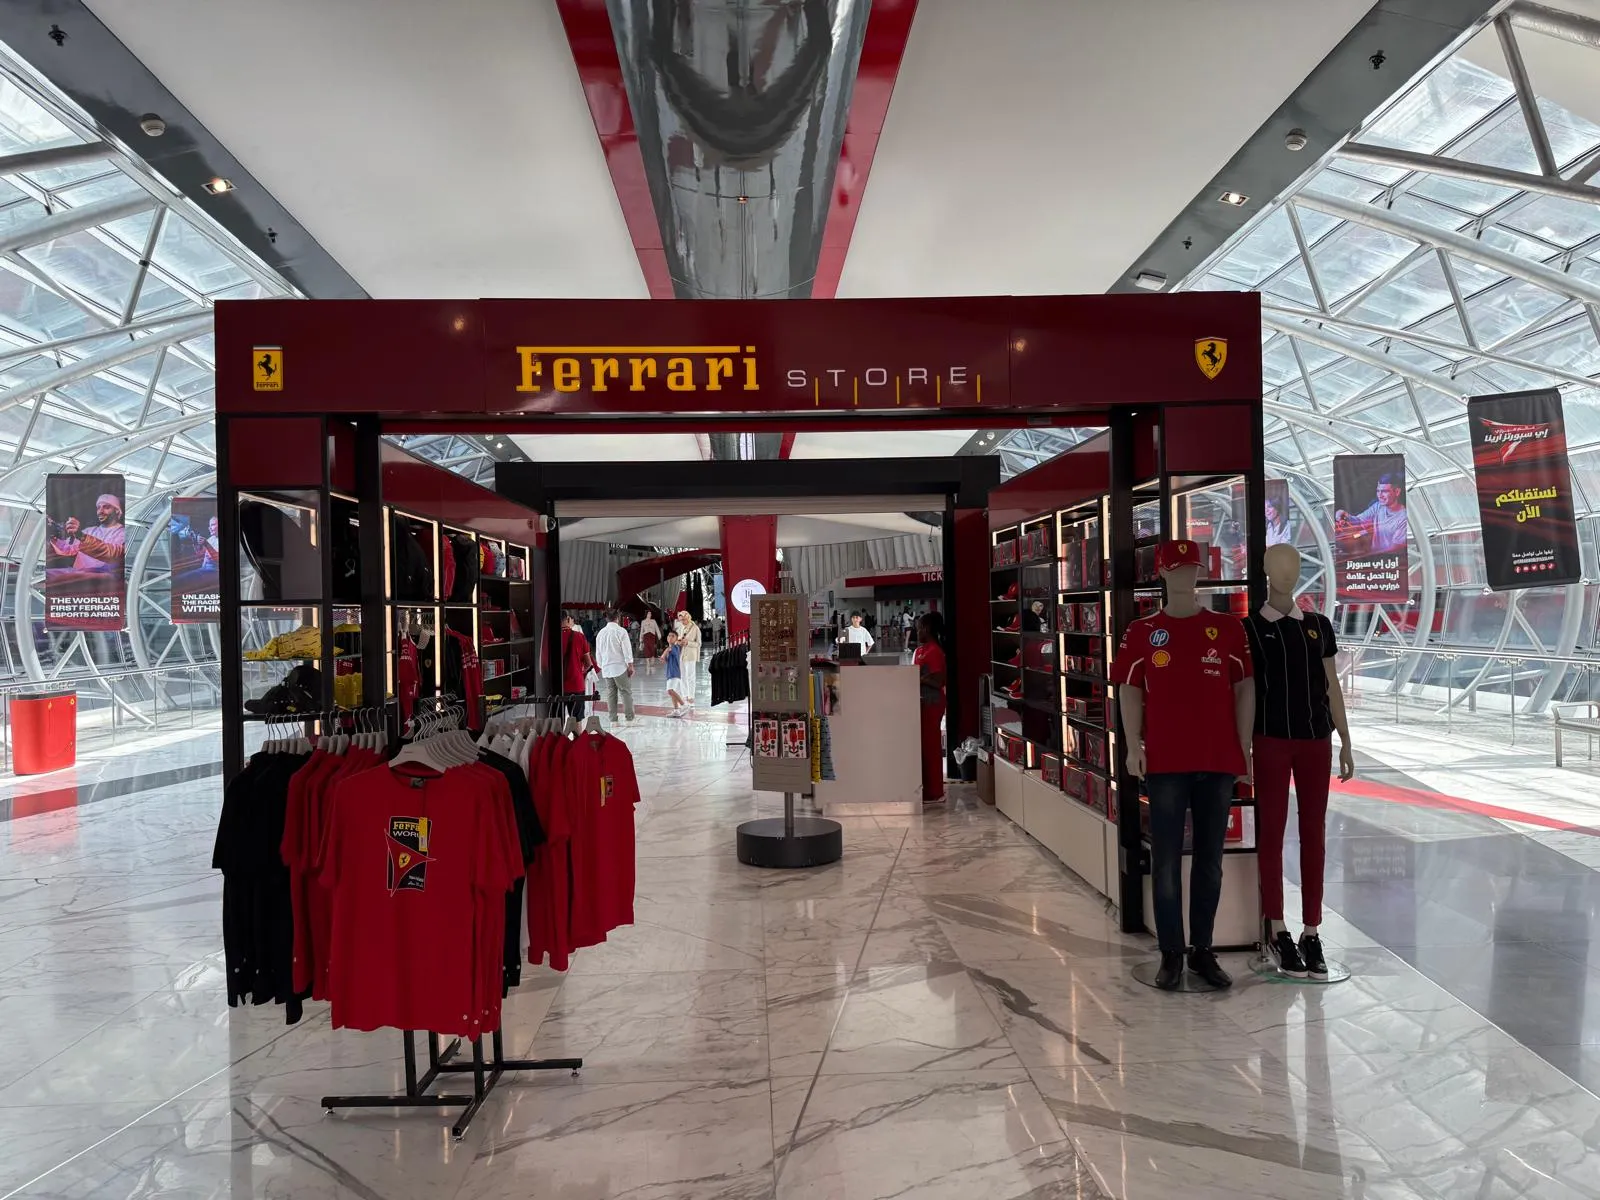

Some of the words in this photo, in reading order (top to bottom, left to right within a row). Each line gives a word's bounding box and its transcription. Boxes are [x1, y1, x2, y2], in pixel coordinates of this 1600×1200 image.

[516, 346, 760, 392] Ferrari
[787, 367, 967, 388] STORE
[1495, 486, 1557, 508] نستقبلكم
[1516, 503, 1541, 523] الآن
[1346, 560, 1371, 570] سبورتز
[1385, 556, 1399, 569] أول
[921, 570, 943, 582] TICK
[1367, 572, 1385, 581] تحمل
[1346, 583, 1366, 592] العالم
[1366, 583, 1379, 591] في
[1152, 629, 1166, 646] hp
[392, 821, 420, 831] Ferra
